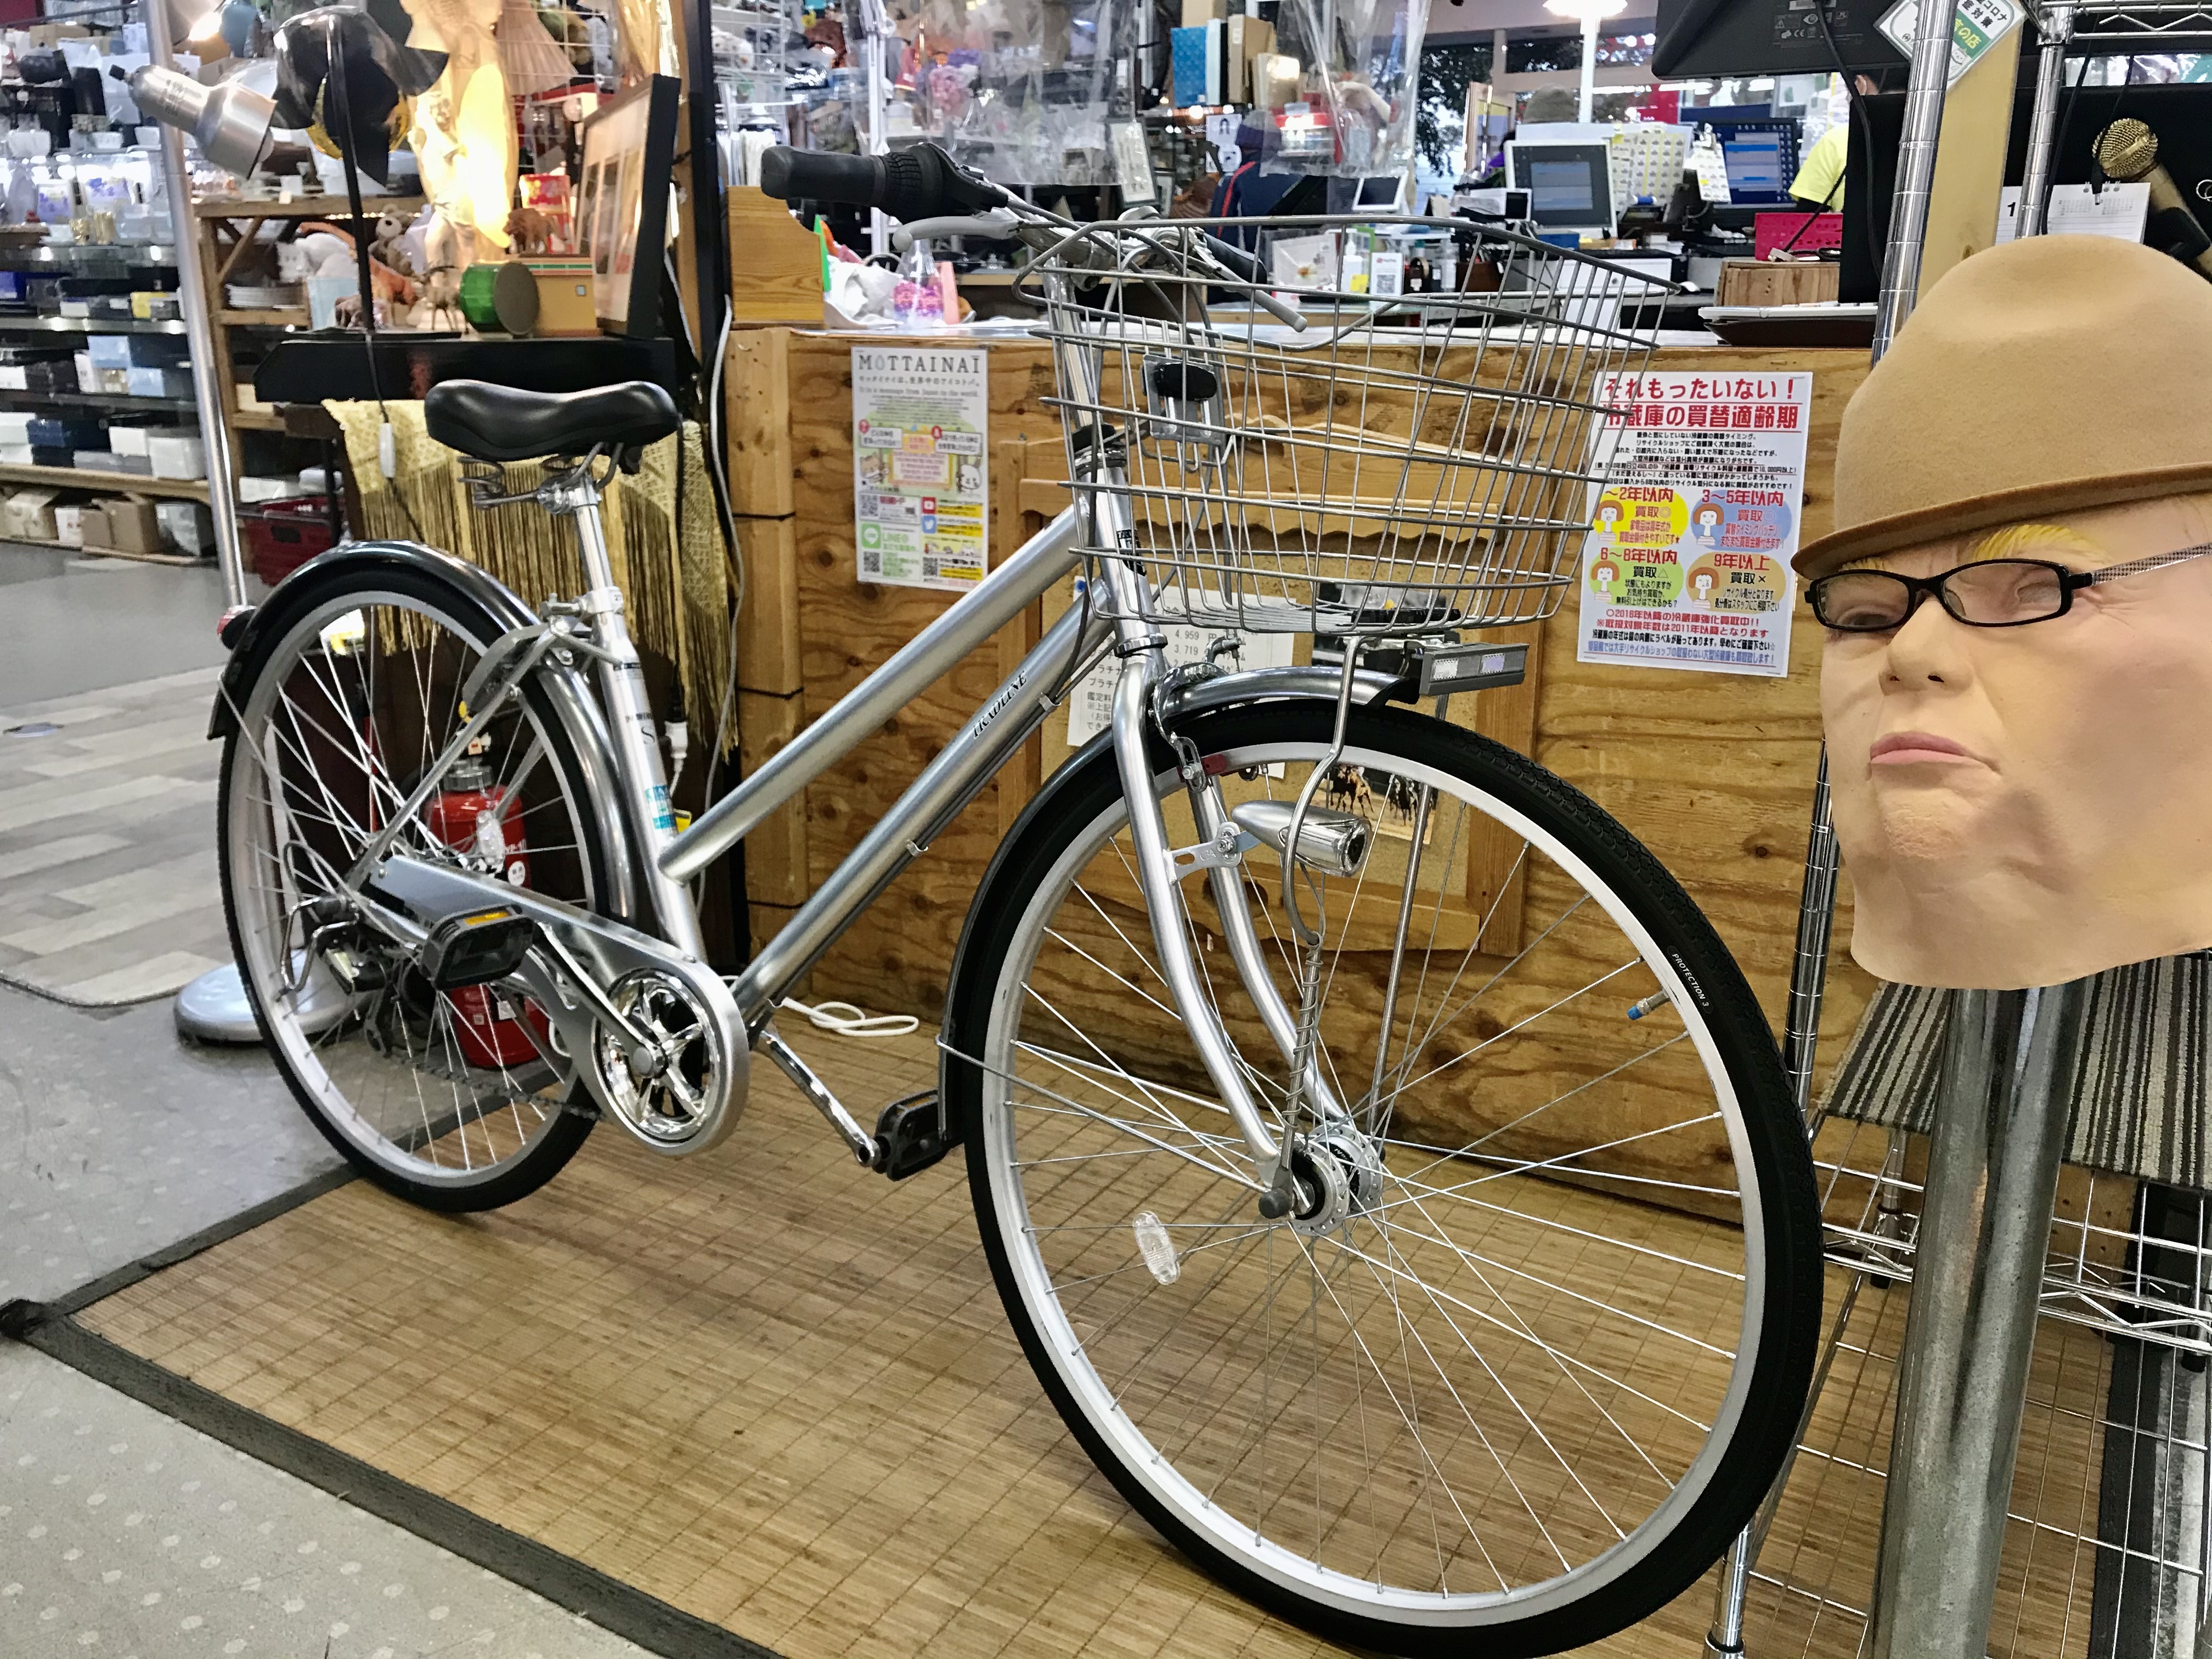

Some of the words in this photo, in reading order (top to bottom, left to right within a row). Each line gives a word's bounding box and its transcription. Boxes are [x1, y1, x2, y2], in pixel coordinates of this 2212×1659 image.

[2007, 202, 2016, 217] 1
[1714, 553, 1771, 571] 9年以上
[1672, 953, 1706, 1000] PROTECTION
